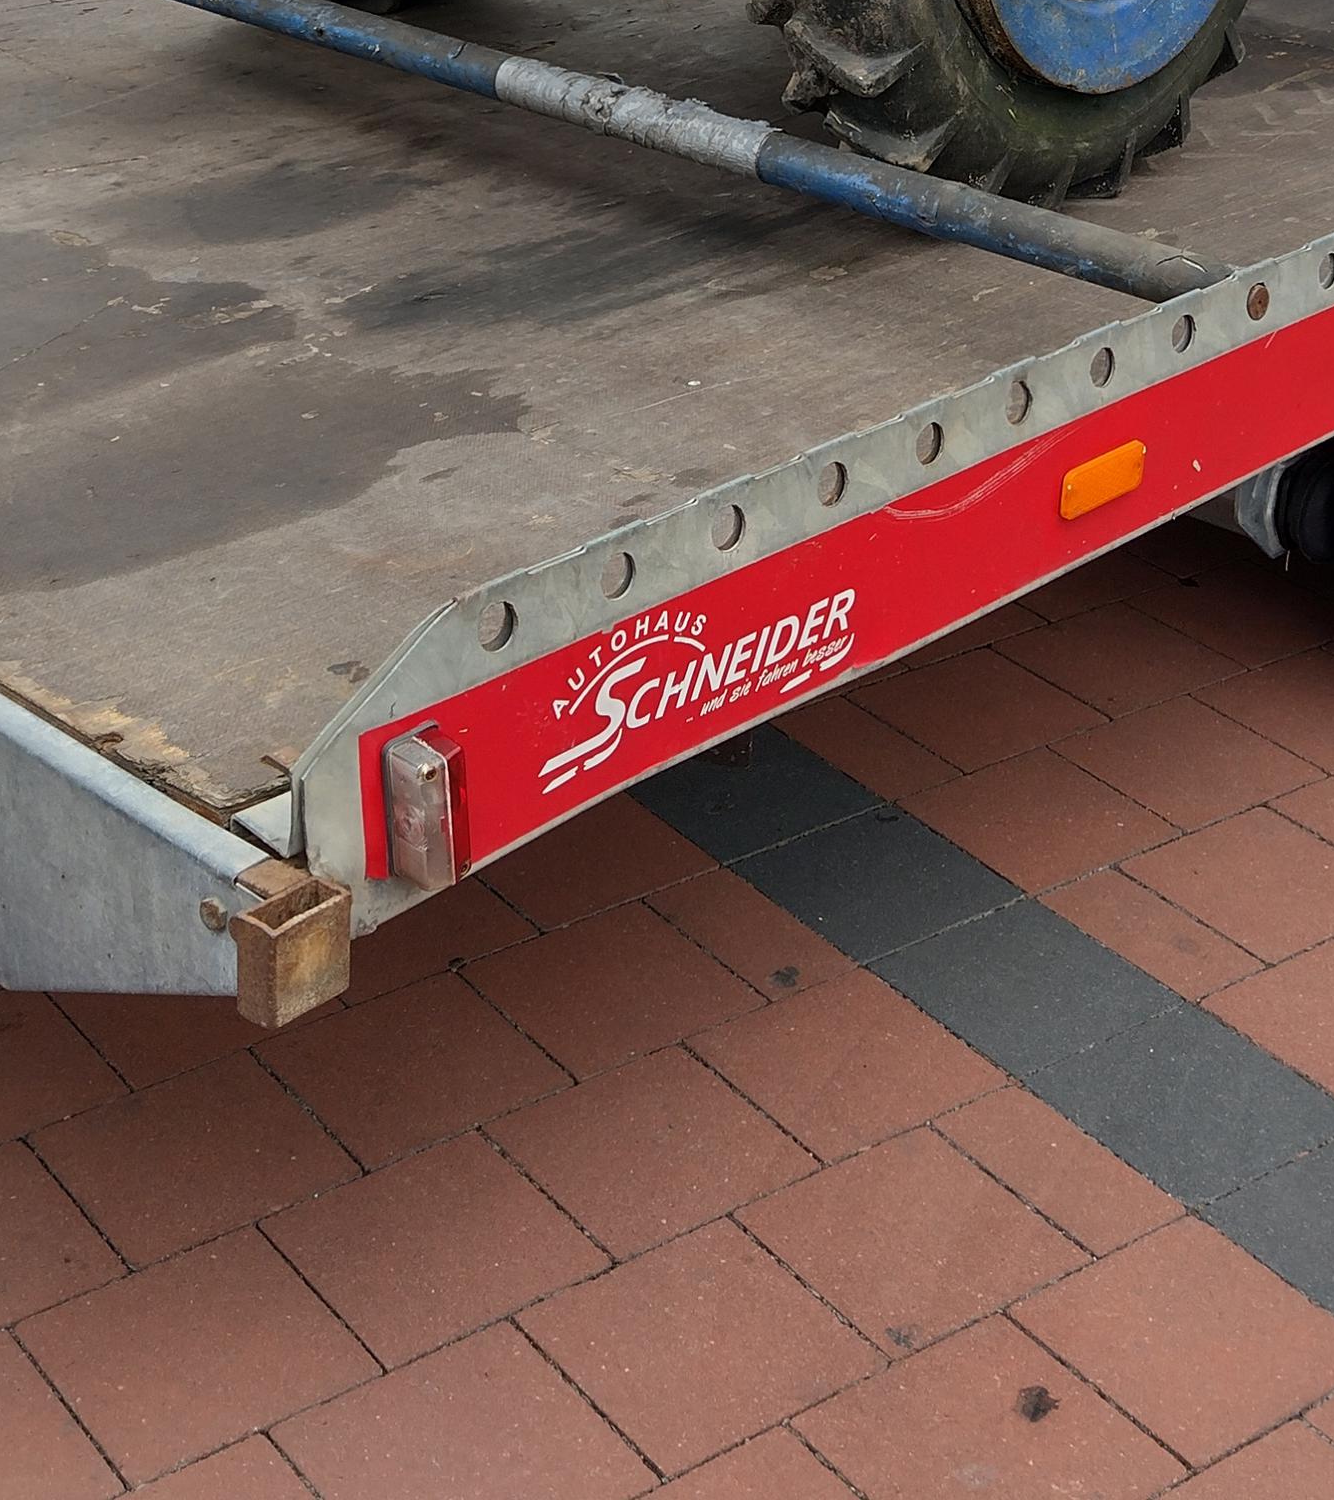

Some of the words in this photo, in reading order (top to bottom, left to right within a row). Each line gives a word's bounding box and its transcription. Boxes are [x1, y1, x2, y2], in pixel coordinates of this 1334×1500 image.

[552, 610, 707, 719] AUTOHAUS
[699, 693, 727, 717] und
[729, 682, 752, 703] sie
[755, 661, 798, 692] fahren
[802, 634, 849, 668] besser
